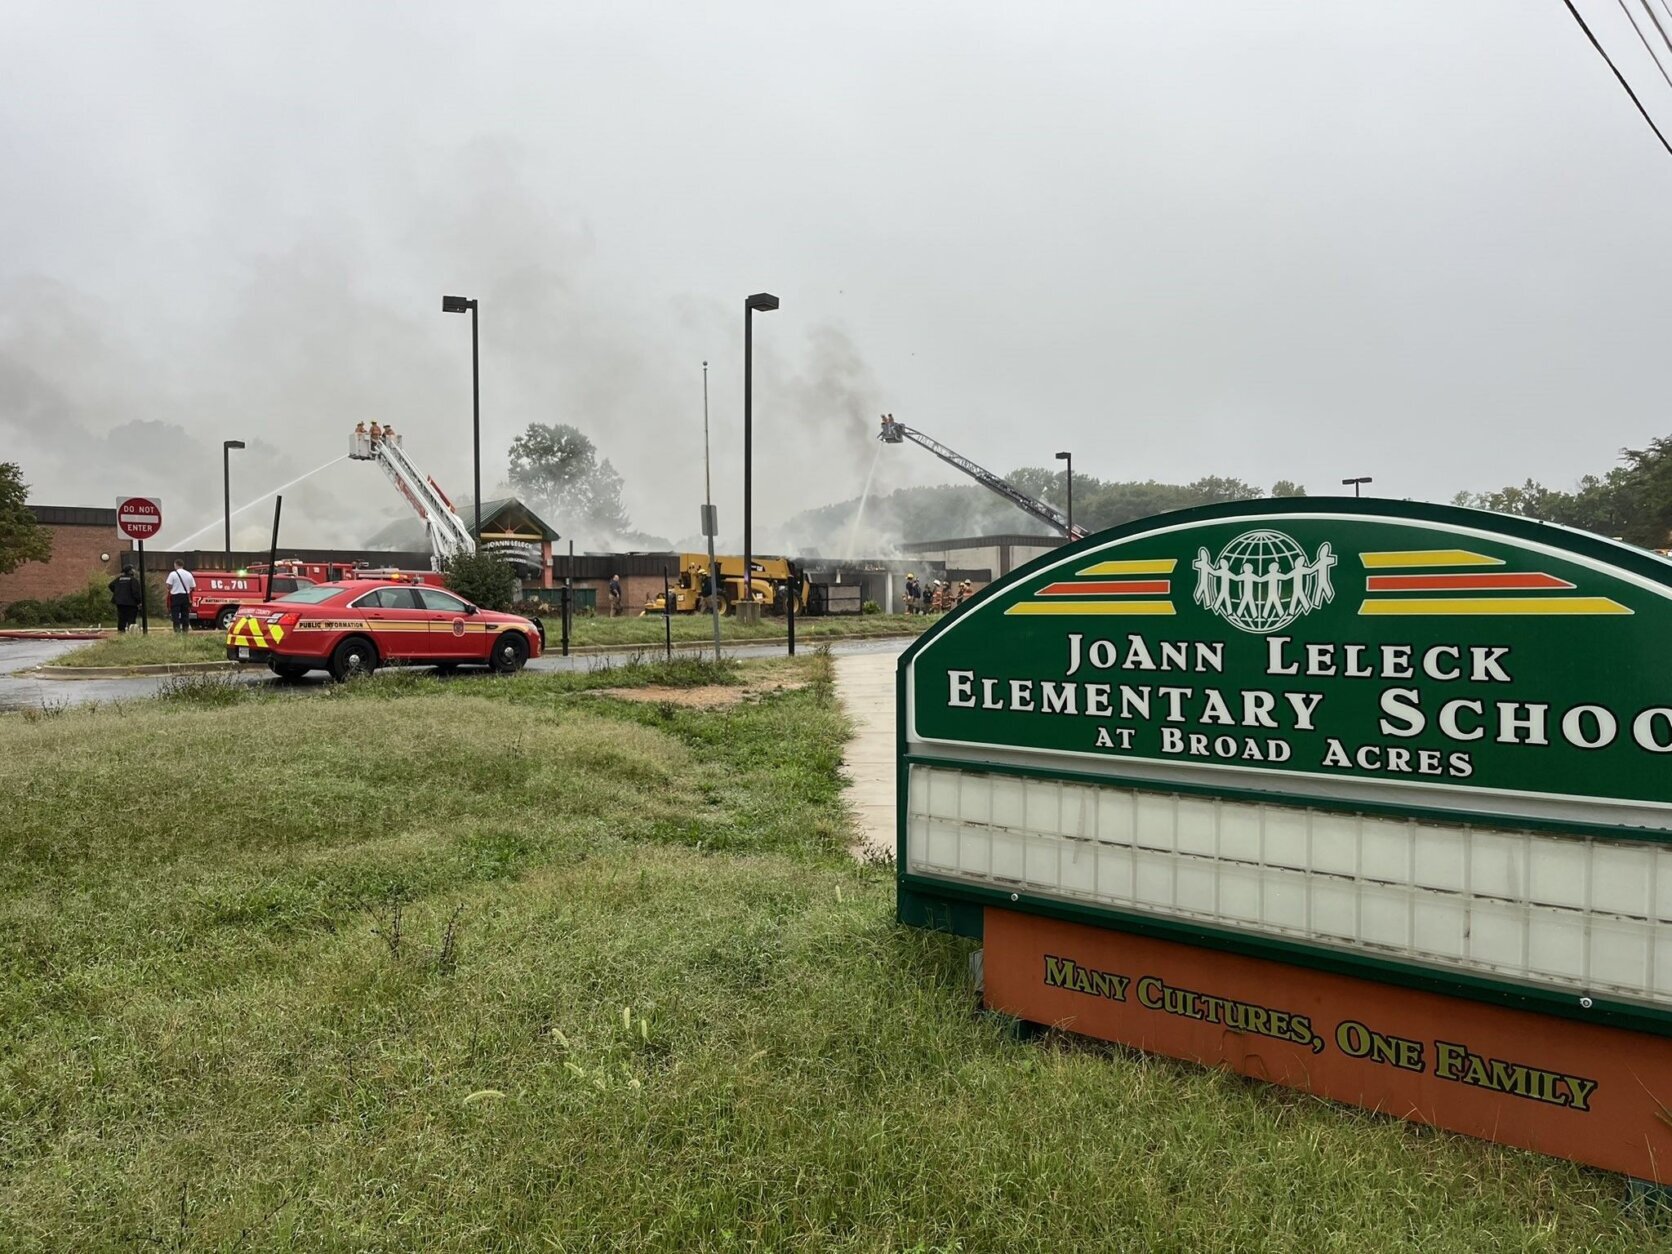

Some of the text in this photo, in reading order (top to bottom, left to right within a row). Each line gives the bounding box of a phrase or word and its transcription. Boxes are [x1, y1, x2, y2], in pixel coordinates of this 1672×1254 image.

[123, 505, 155, 514] DO NOT
[127, 524, 153, 532] ENTER
[210, 579, 223, 589] BC
[231, 580, 248, 590] 701
[1066, 633, 1511, 682] JOANN LELECK
[946, 669, 1324, 731] ELEMENTARY
[1095, 727, 1473, 777] AT BROAD ACRES
[1044, 955, 1599, 1112] MANY CULTURES, ONE FAMILY
